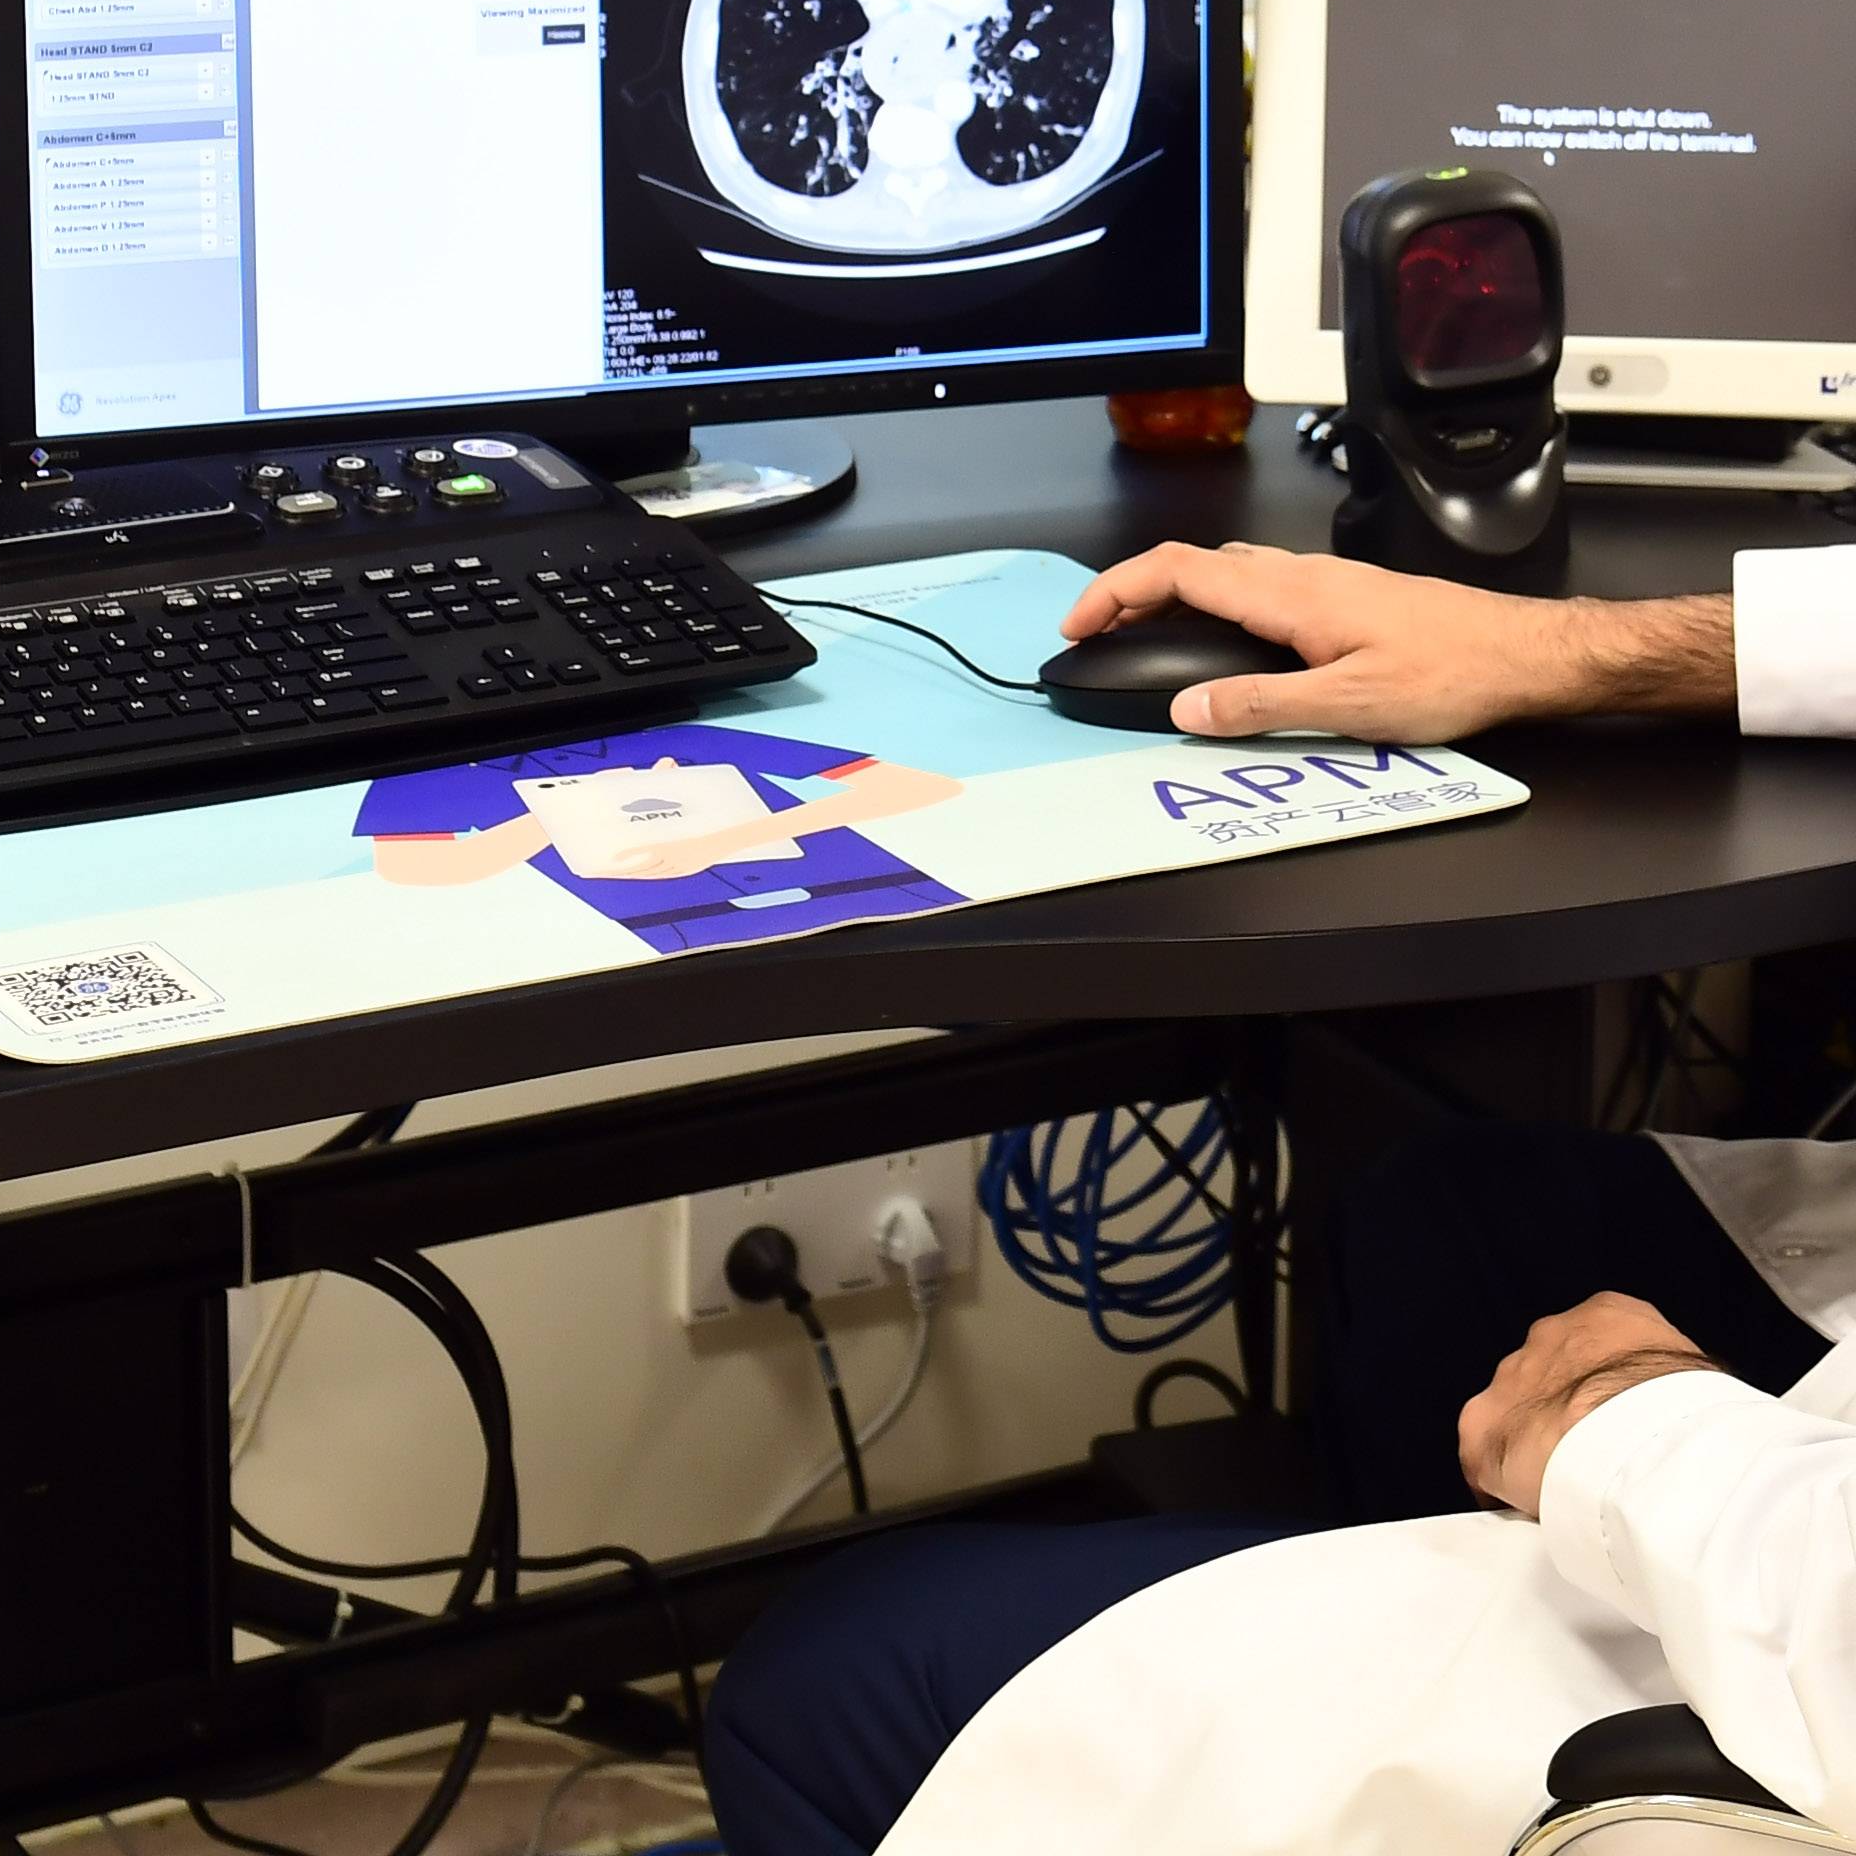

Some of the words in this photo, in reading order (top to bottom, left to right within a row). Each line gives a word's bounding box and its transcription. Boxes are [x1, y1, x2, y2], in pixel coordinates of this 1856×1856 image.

[480, 8, 525, 18] Viewing
[528, 5, 586, 15] Maximized
[40, 46, 68, 58] Head
[71, 45, 108, 56] STAND
[1496, 103, 1533, 125] The
[1532, 107, 1598, 130] system
[1597, 106, 1616, 127] is
[1616, 107, 1657, 128] shut
[43, 133, 94, 146] Abdomen
[1450, 126, 1489, 148] You
[1488, 130, 1524, 148] can
[1523, 130, 1565, 148] now
[1564, 129, 1624, 150] switch
[1622, 130, 1650, 152] off
[1648, 131, 1681, 152] the
[9, 669, 21, 678] Y
[58, 663, 70, 672] U
[1152, 744, 1450, 821] APM
[629, 810, 683, 823] APM
[1190, 781, 1502, 844] 资产云管家
